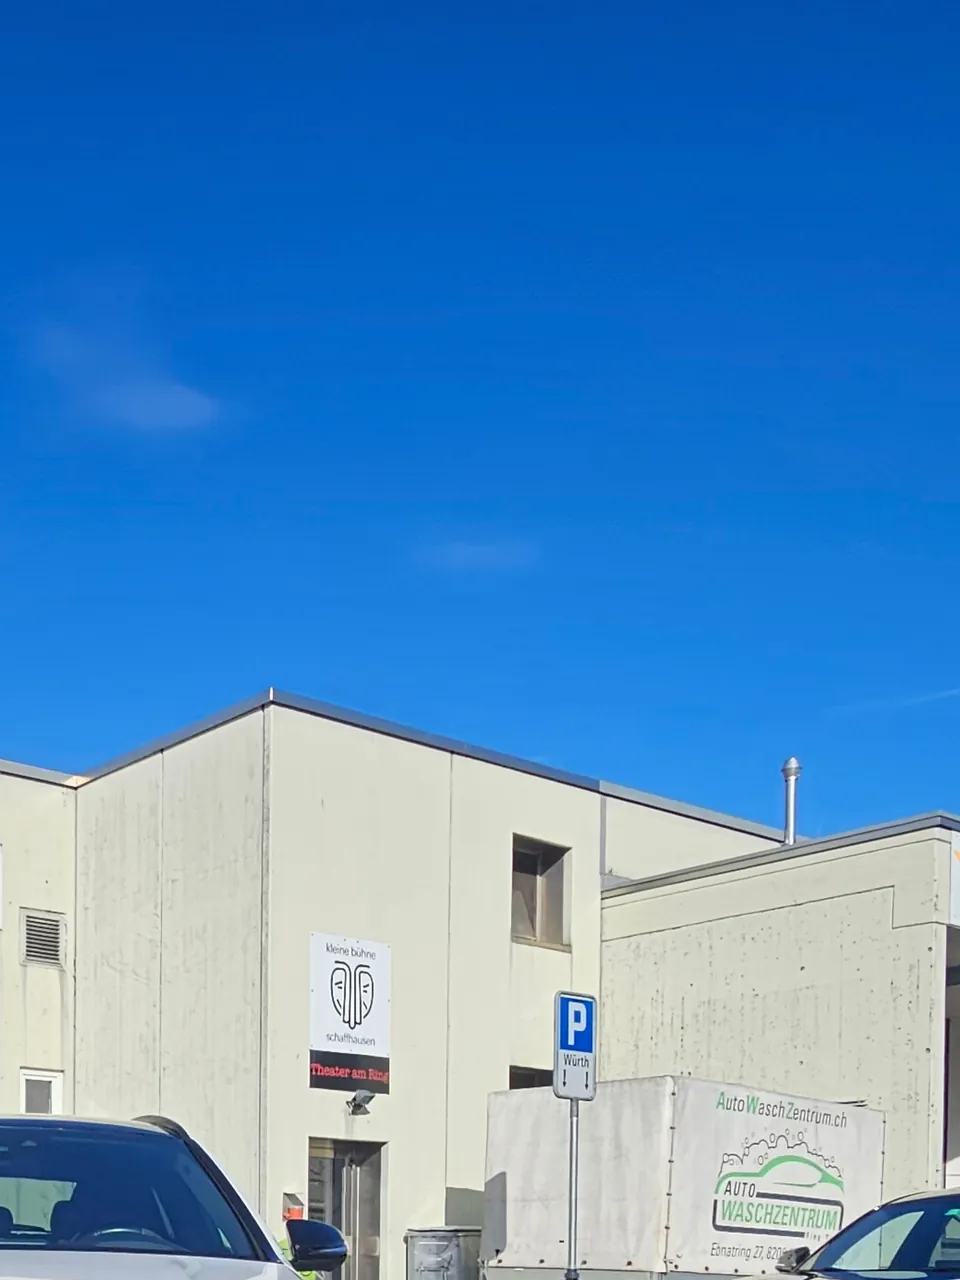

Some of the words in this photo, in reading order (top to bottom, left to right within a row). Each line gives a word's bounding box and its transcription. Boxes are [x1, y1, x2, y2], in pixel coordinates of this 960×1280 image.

[326, 942, 349, 956] kleine
[351, 946, 376, 960] bühne
[568, 1001, 587, 1046] P
[326, 1032, 376, 1046] schaffhausen
[563, 1053, 590, 1068] Würth
[310, 1063, 351, 1078] Theater
[351, 1068, 367, 1080] am
[368, 1068, 390, 1085] Ring
[716, 1091, 848, 1129] AutoWaschZentrum.ch
[723, 1180, 757, 1199] AUTO
[720, 1199, 839, 1232] WASCHZENTRUM
